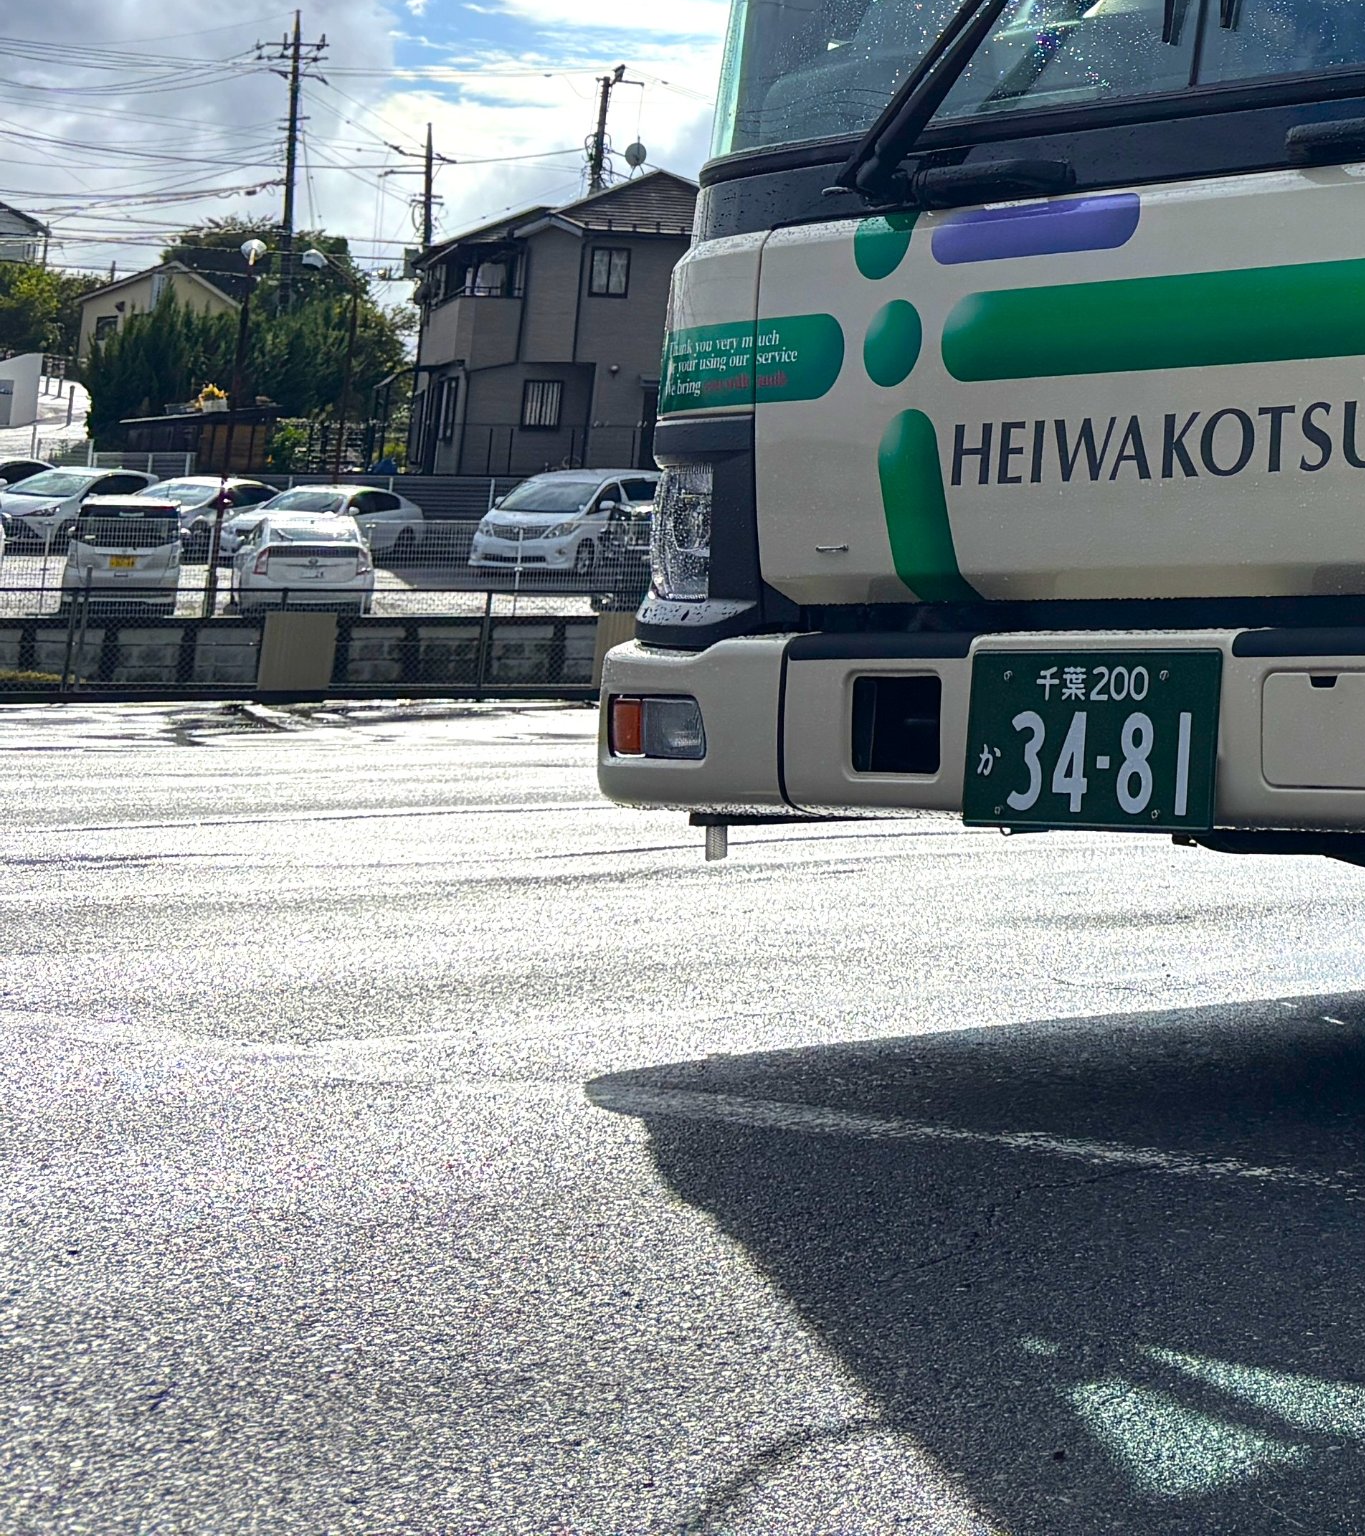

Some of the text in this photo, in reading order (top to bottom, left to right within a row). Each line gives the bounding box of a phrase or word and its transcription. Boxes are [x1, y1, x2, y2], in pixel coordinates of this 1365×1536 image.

[678, 358, 698, 377] your
[700, 353, 726, 371] using
[729, 354, 750, 367] our
[756, 346, 798, 364] service
[695, 341, 712, 357] you
[716, 337, 738, 354] very
[677, 379, 702, 397] bring
[1036, 666, 1149, 701] 千葉200
[977, 711, 1192, 816] か 34-81
